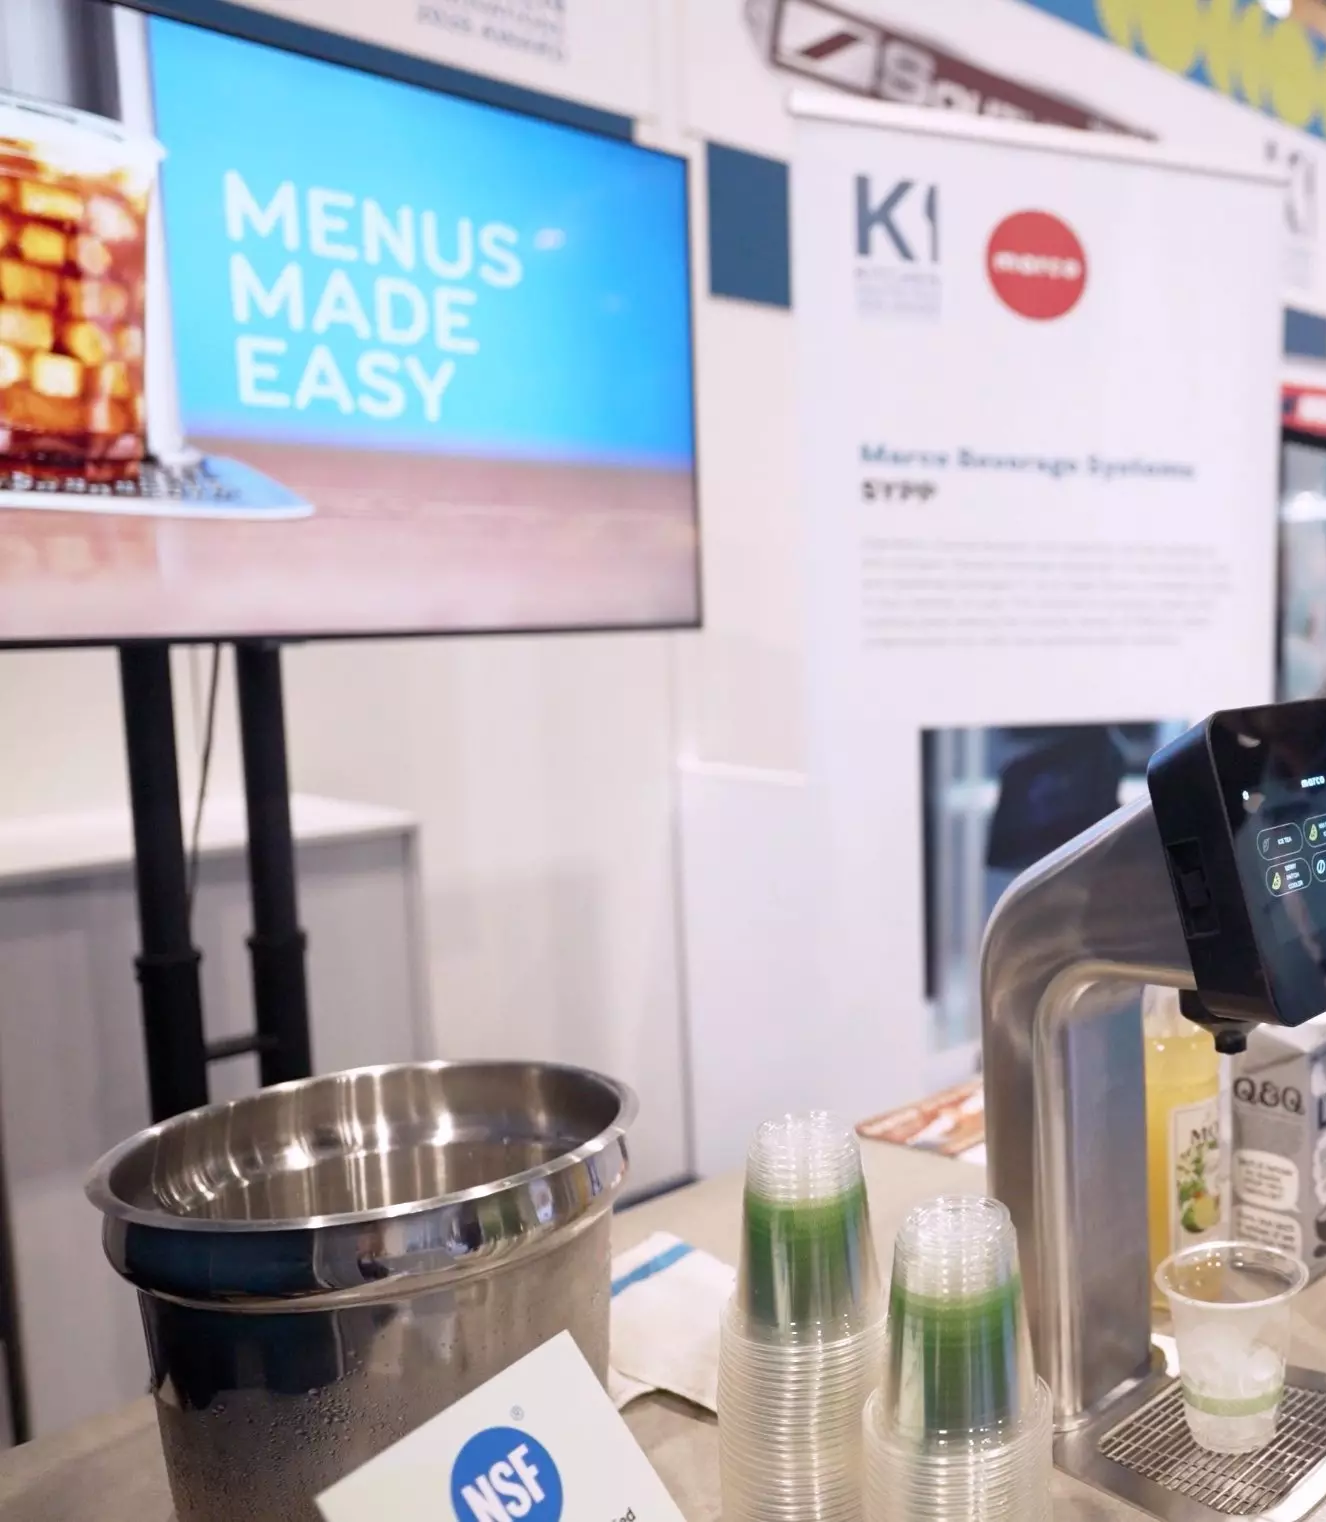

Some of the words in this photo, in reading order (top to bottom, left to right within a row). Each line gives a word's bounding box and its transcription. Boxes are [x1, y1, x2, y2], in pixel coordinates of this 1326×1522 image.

[223, 168, 523, 288] MENUS
[229, 253, 480, 355] MADE
[235, 335, 456, 422] EASY
[1301, 775, 1325, 788] marco
[461, 1443, 546, 1522] NSF
